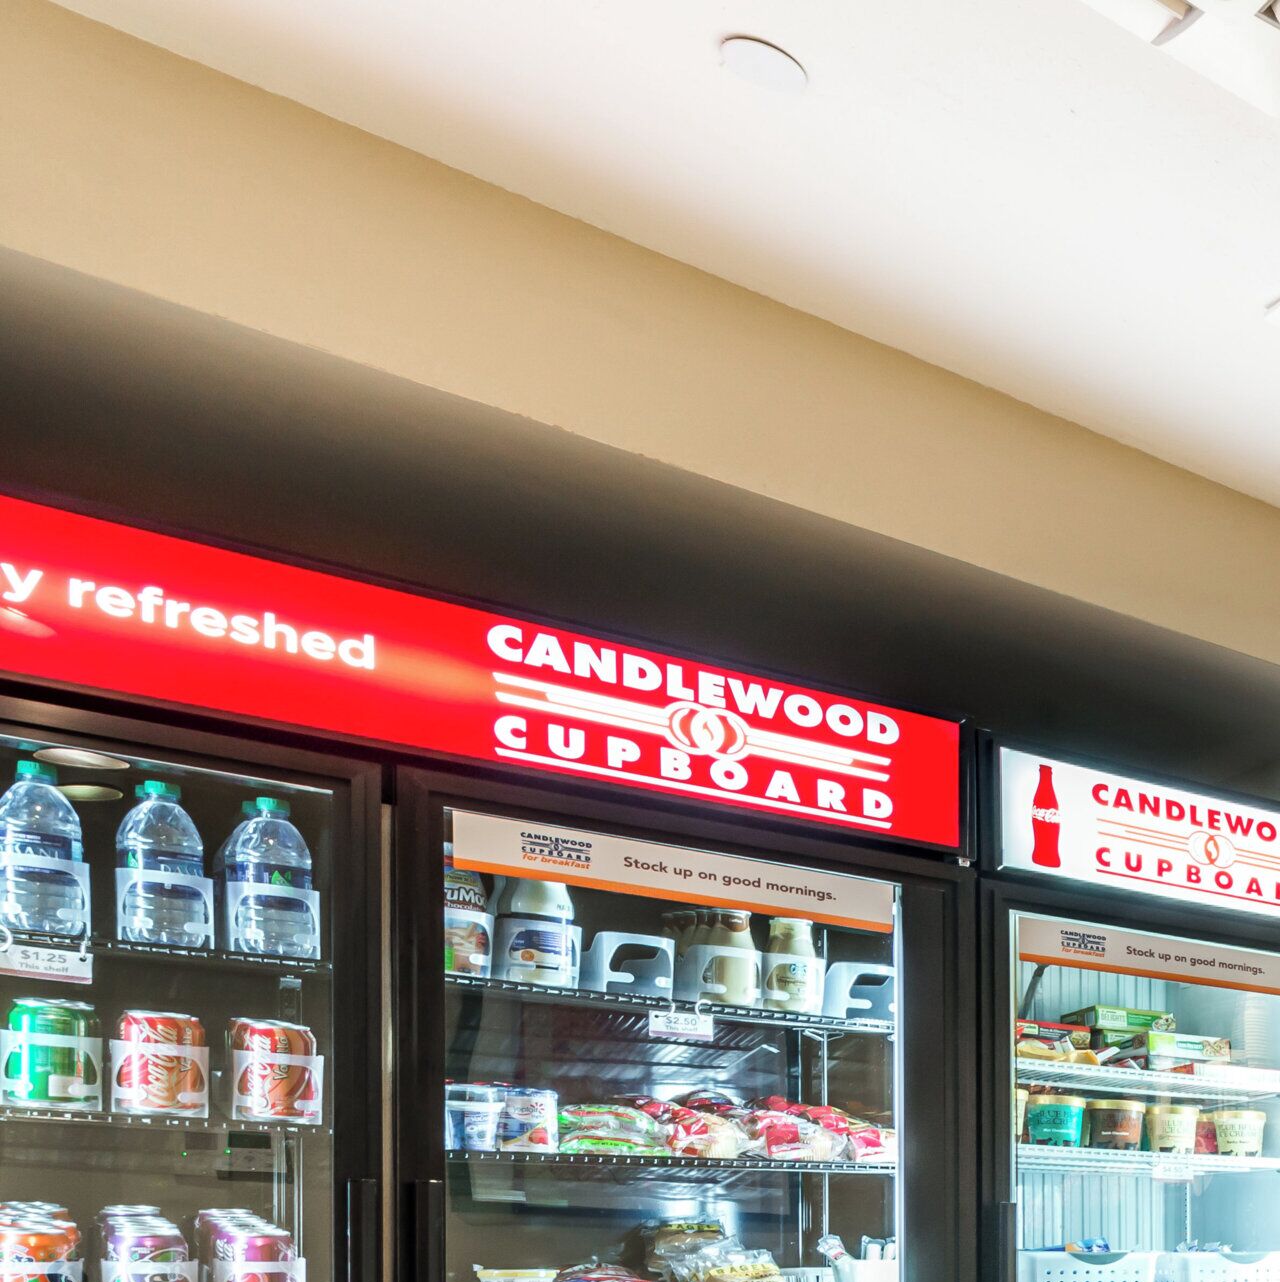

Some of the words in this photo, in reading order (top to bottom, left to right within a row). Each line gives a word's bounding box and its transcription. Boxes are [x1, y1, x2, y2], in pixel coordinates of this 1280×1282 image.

[68, 577, 377, 671] refreshed
[486, 624, 900, 745] CANDLEWOOD
[494, 715, 894, 820] CUPBOARD
[520, 831, 592, 849] CANDLEWOOD
[521, 846, 591, 862] CUPBOARD
[522, 853, 537, 863] for
[541, 855, 591, 870] breakfast
[624, 856, 668, 874] Stock
[673, 866, 693, 879] up
[698, 870, 717, 882] on
[722, 874, 761, 889] good
[766, 882, 837, 902] mornings.
[1060, 929, 1106, 942] CANDLEWOOD
[1061, 940, 1106, 952] CUPBOARD
[21, 949, 67, 964] $1.25
[1126, 945, 1155, 958] Stock
[1158, 951, 1171, 962] up
[1174, 953, 1187, 963] on
[1190, 957, 1216, 969] good
[1218, 960, 1265, 975] mornings.
[18, 961, 41, 971] This
[44, 964, 69, 974] shelf
[666, 1015, 697, 1027] $2.50
